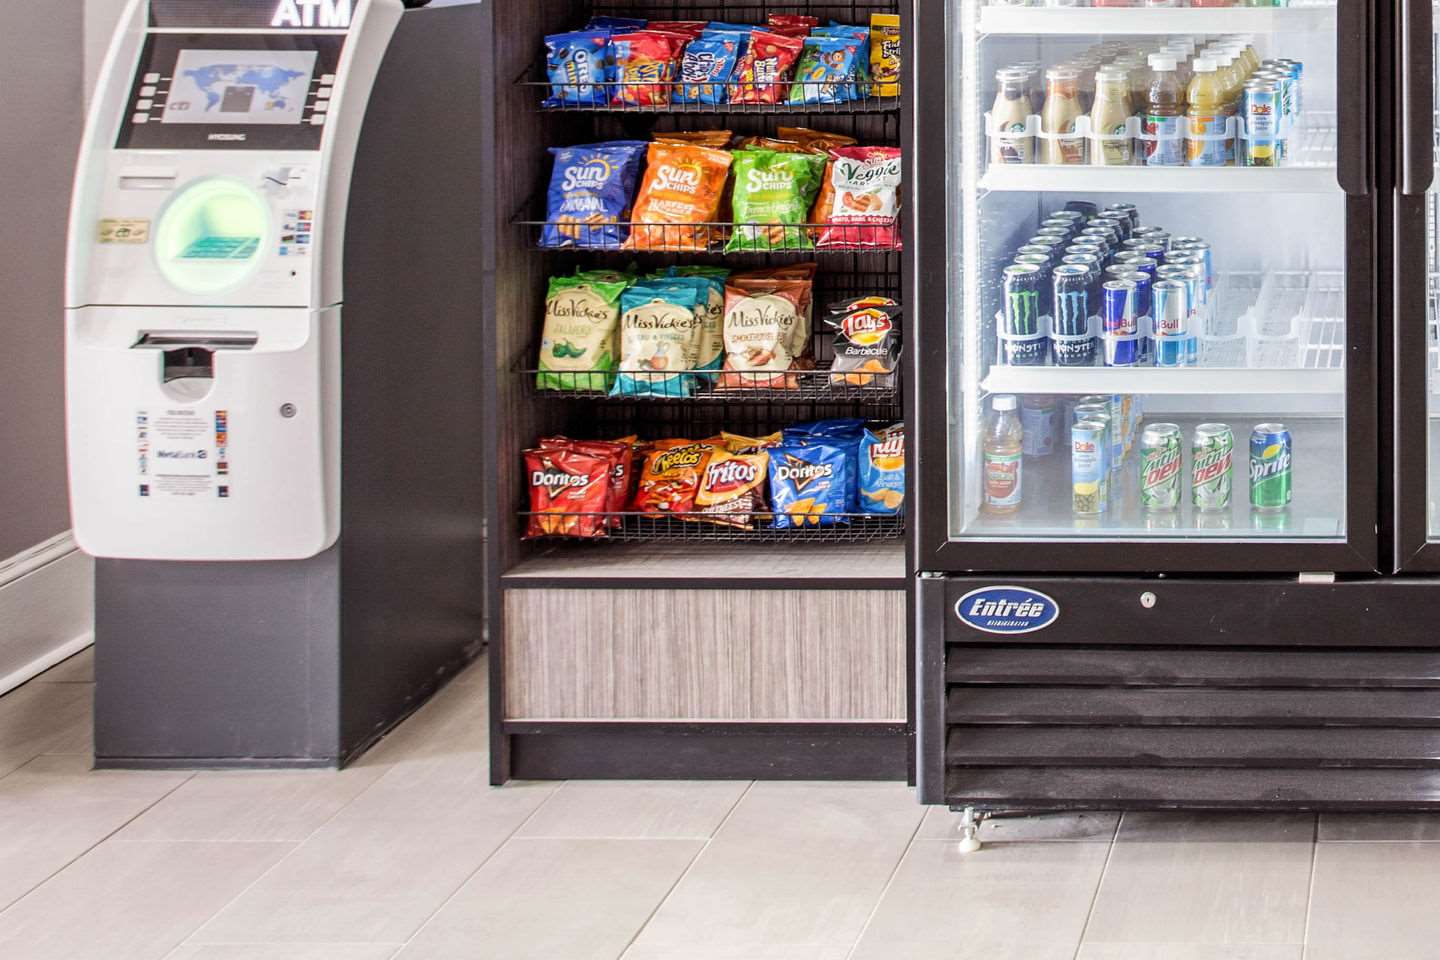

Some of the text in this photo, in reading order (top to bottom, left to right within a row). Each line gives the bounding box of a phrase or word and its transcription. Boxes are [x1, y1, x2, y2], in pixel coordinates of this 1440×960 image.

[1251, 104, 1272, 114] Dole
[562, 165, 609, 191] Sun
[576, 181, 603, 190] CHIPS
[649, 164, 700, 194] Sun
[746, 168, 793, 193] Sun
[667, 183, 696, 194] CHIPS
[650, 312, 693, 332] Vickie's
[756, 305, 795, 332] Vickie's
[845, 346, 889, 356] Barbecue
[777, 463, 833, 481] Doritos
[1250, 451, 1290, 482] Sprite
[532, 471, 589, 487] Doritos
[969, 598, 1045, 617] Entrée
